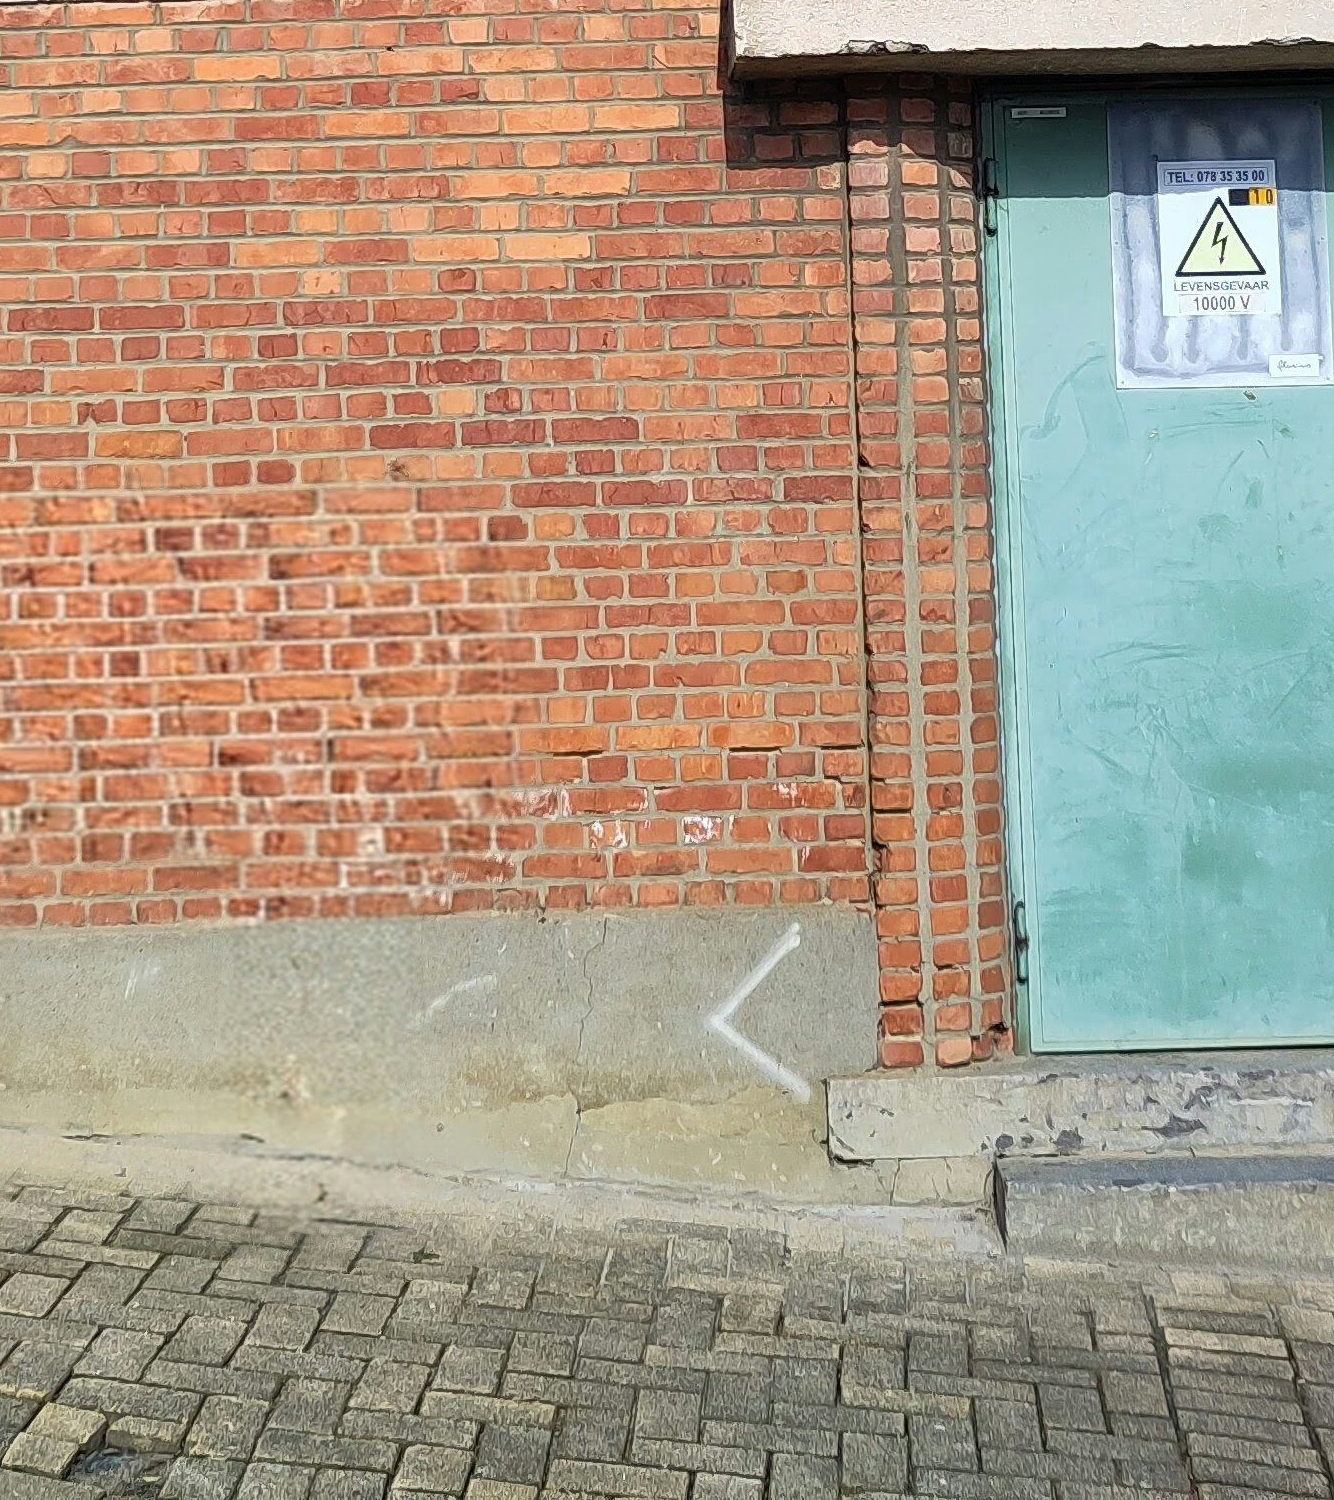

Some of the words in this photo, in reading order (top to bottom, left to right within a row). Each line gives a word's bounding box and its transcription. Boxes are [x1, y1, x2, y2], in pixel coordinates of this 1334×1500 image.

[1167, 171, 1194, 183] TEL:
[1219, 170, 1233, 182] 35
[1235, 170, 1248, 182] 35
[1251, 169, 1265, 182] 00
[1253, 188, 1274, 205] 10
[1173, 280, 1269, 291] LEVENSGEVAAR
[1193, 295, 1235, 311] 10000
[1240, 294, 1250, 309] V
